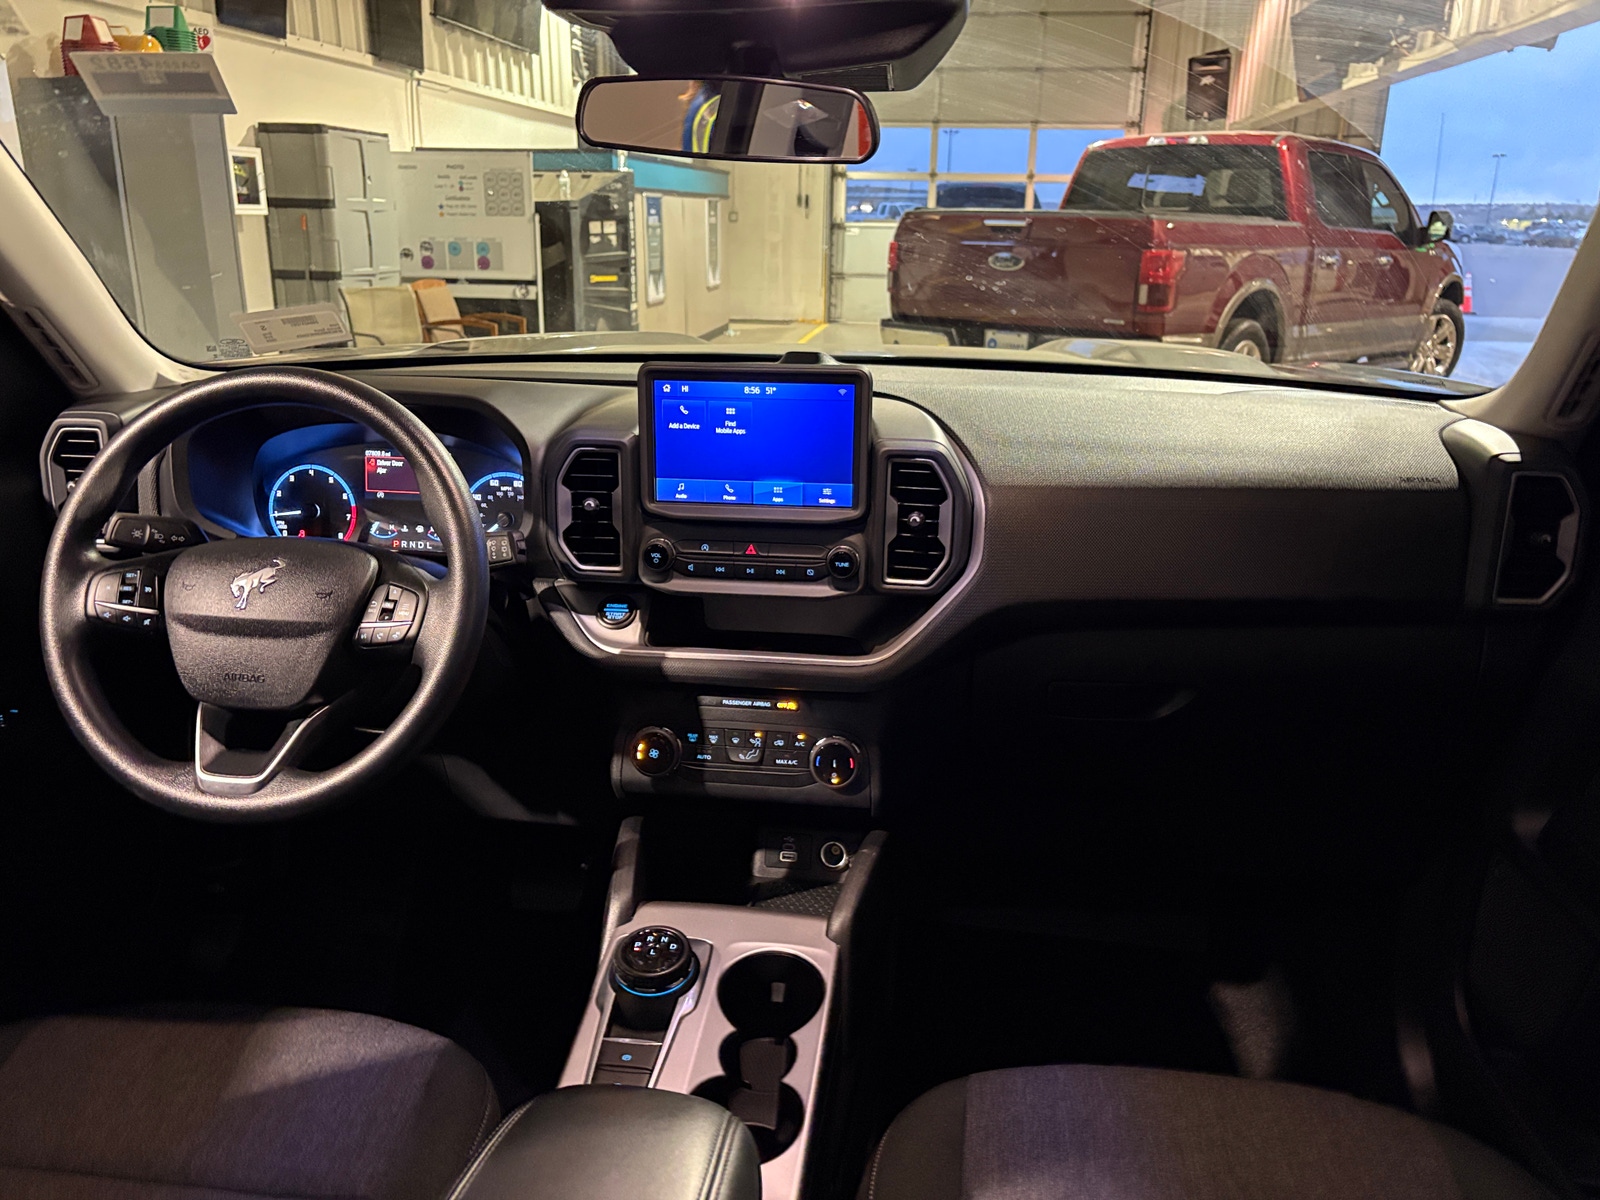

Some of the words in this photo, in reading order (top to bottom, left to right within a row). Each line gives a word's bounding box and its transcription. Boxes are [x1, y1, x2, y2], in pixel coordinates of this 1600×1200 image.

[193, 27, 209, 35] AED
[681, 385, 689, 393] HI
[744, 386, 761, 394] 8:56
[765, 386, 777, 394] 51°
[223, 672, 265, 683] AIRBAG
[649, 948, 656, 956] L
